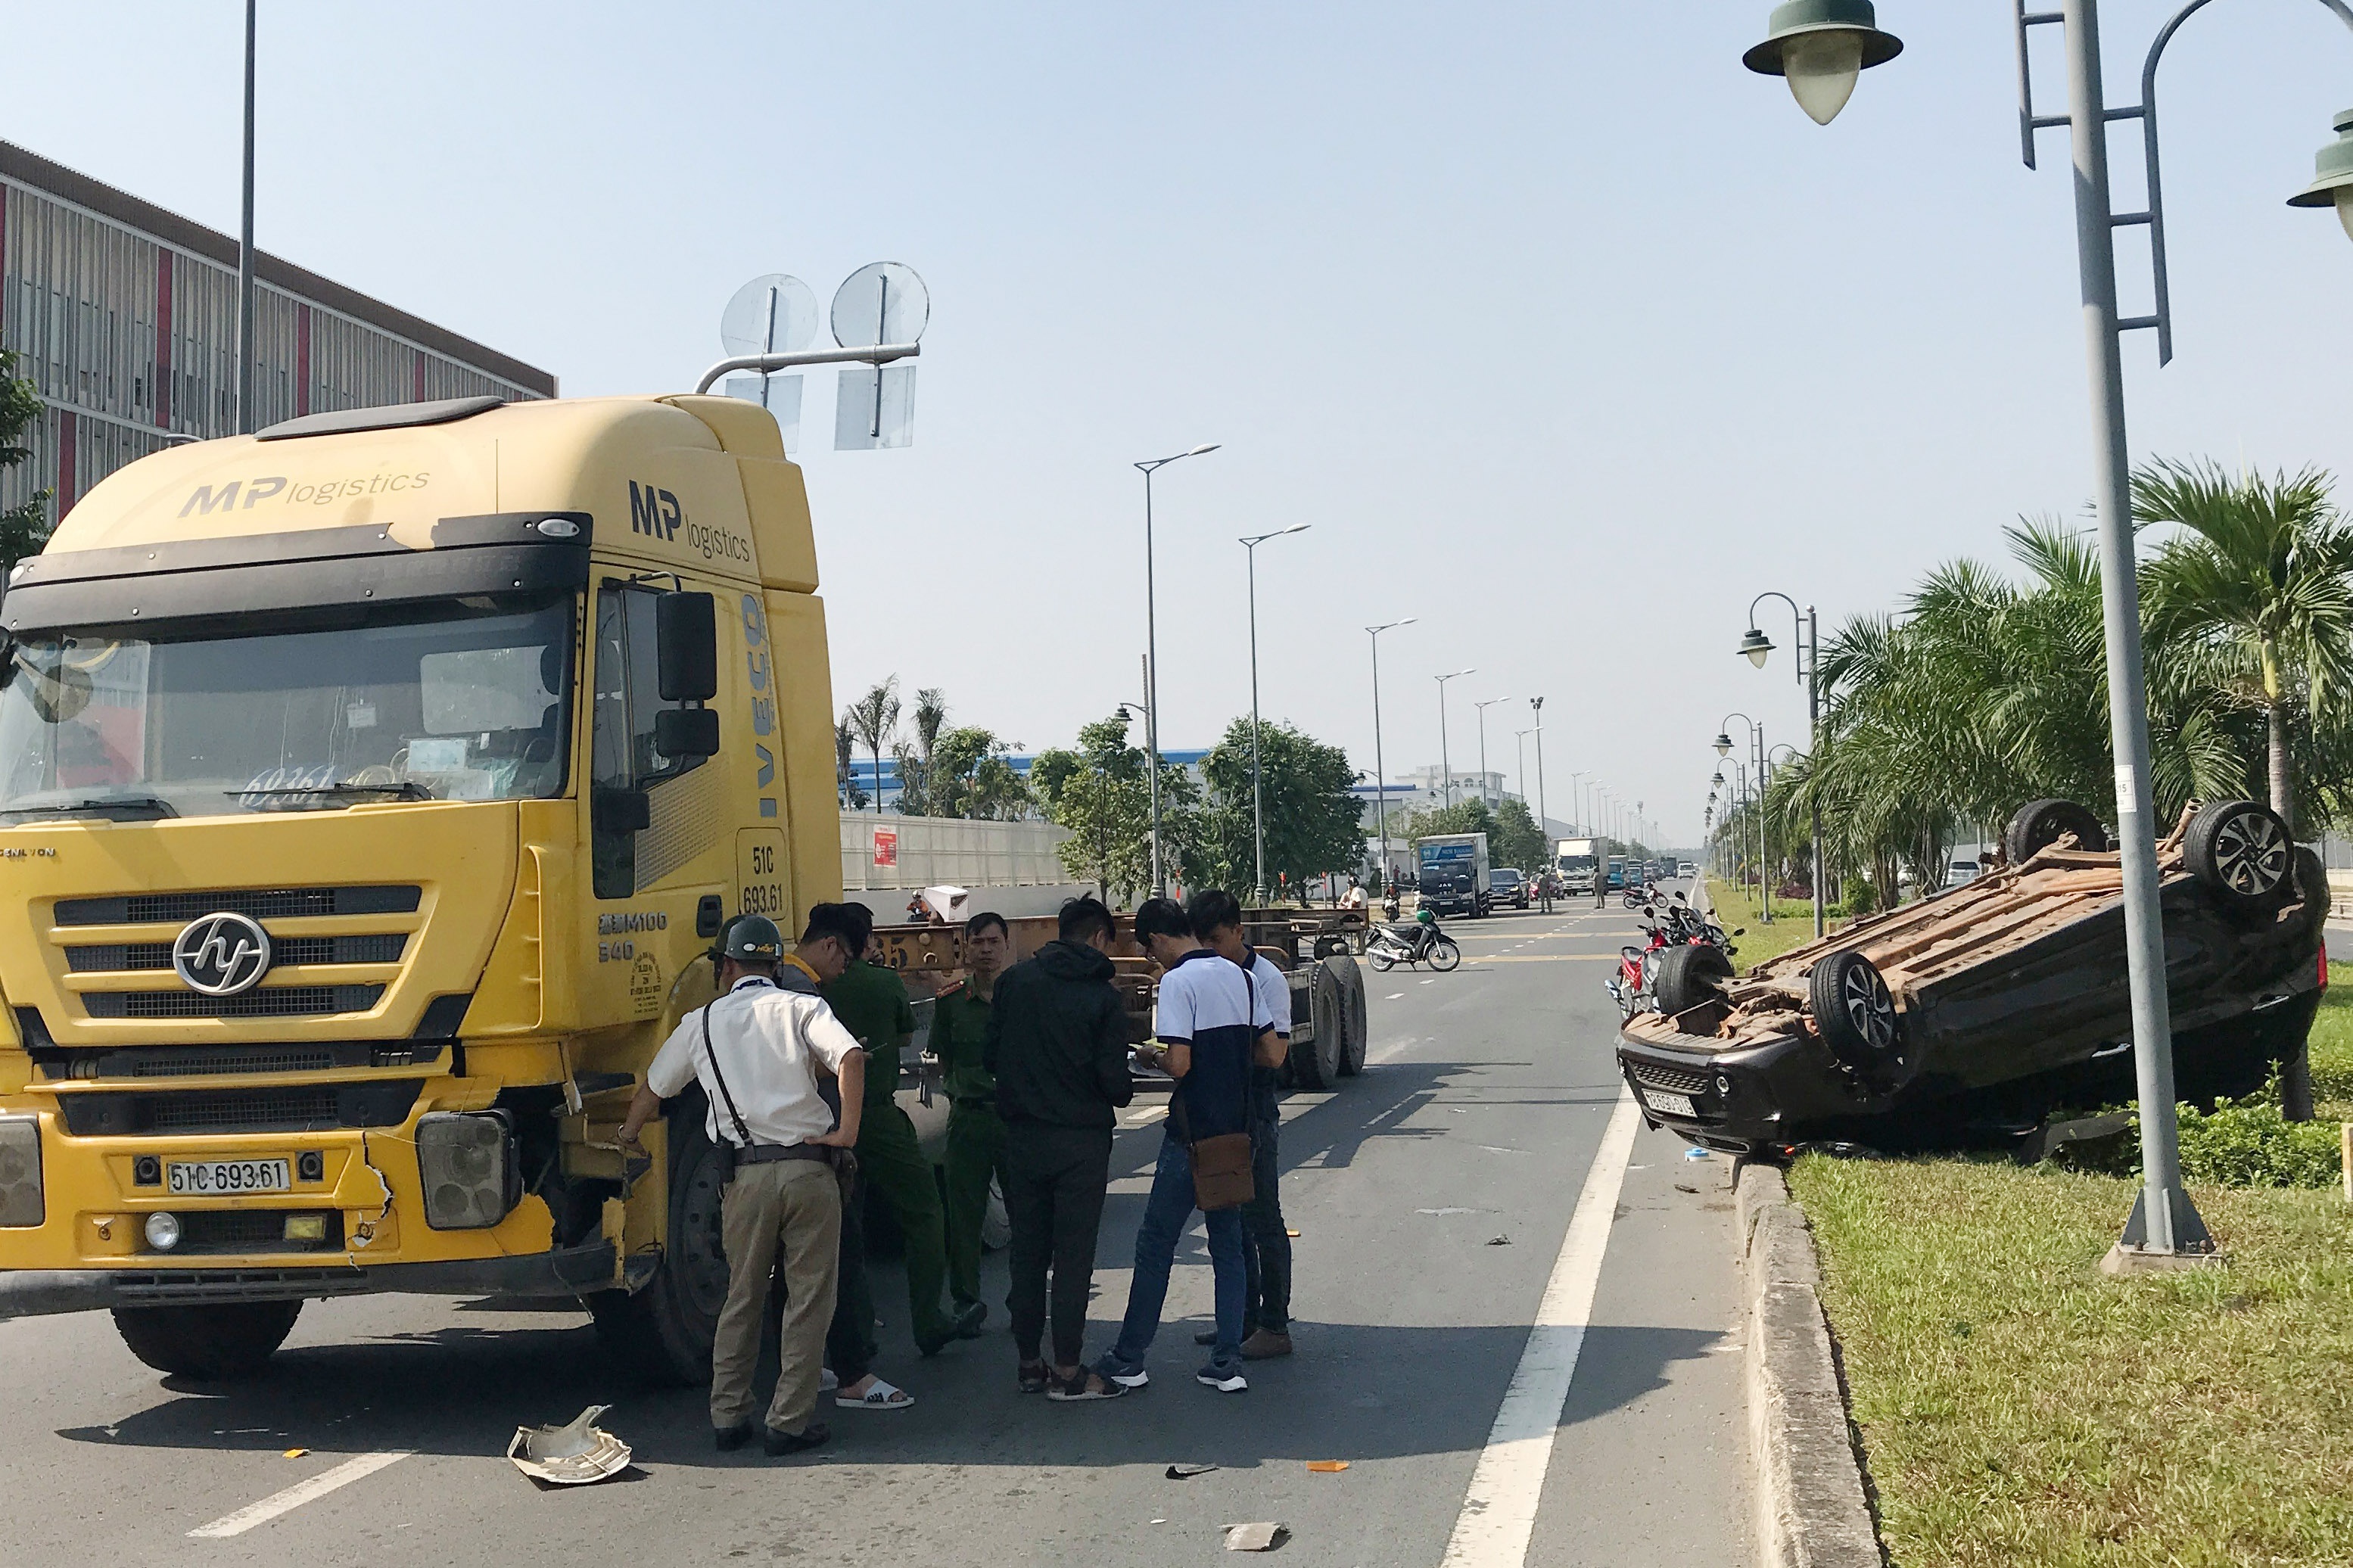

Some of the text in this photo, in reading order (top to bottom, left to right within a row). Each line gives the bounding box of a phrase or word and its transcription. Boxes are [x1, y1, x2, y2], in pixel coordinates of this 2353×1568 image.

[176, 471, 431, 518] MP logistics
[628, 479, 750, 562] MP logistics
[741, 593, 778, 818] IVECO
[752, 845, 773, 875] 51C
[743, 883, 783, 914] 693.61
[170, 1162, 282, 1191] 51C-693.61
